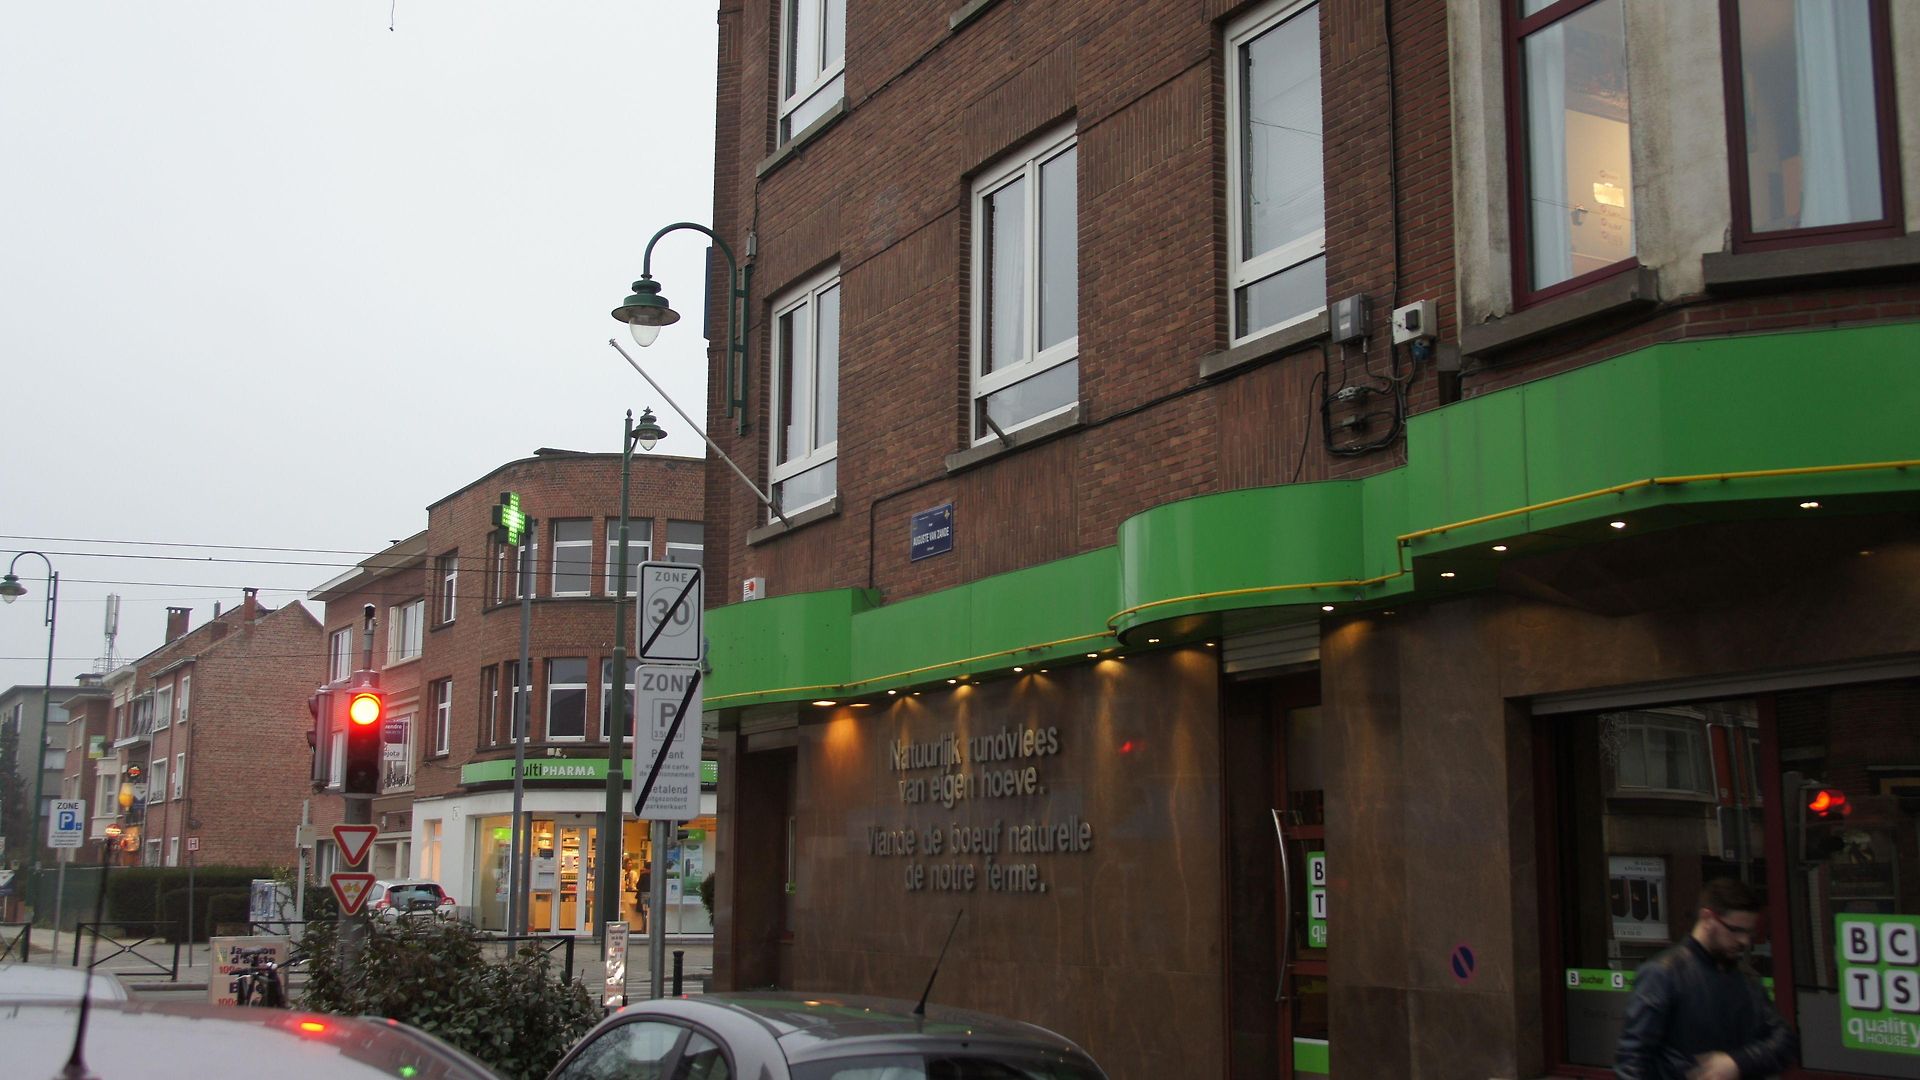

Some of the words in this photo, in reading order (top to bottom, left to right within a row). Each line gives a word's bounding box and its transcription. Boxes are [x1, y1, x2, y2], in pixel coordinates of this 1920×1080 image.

[655, 571, 688, 583] ZONE
[651, 748, 685, 760] Pant
[889, 731, 963, 775] Natuurlijk
[968, 724, 1060, 763] rundvlees
[649, 784, 689, 795] etalend
[898, 777, 926, 803] van
[929, 769, 975, 809] eigen
[57, 802, 79, 810] ZONE
[867, 825, 917, 857] Viande
[923, 825, 944, 856] de
[951, 820, 1003, 856] boeuf
[1008, 814, 1095, 853] naturelle
[904, 859, 925, 891] de
[929, 858, 976, 891] notre
[984, 855, 1048, 894] ferme.
[230, 945, 276, 955] Jaon
[1865, 1032, 1909, 1047] HOUSE
